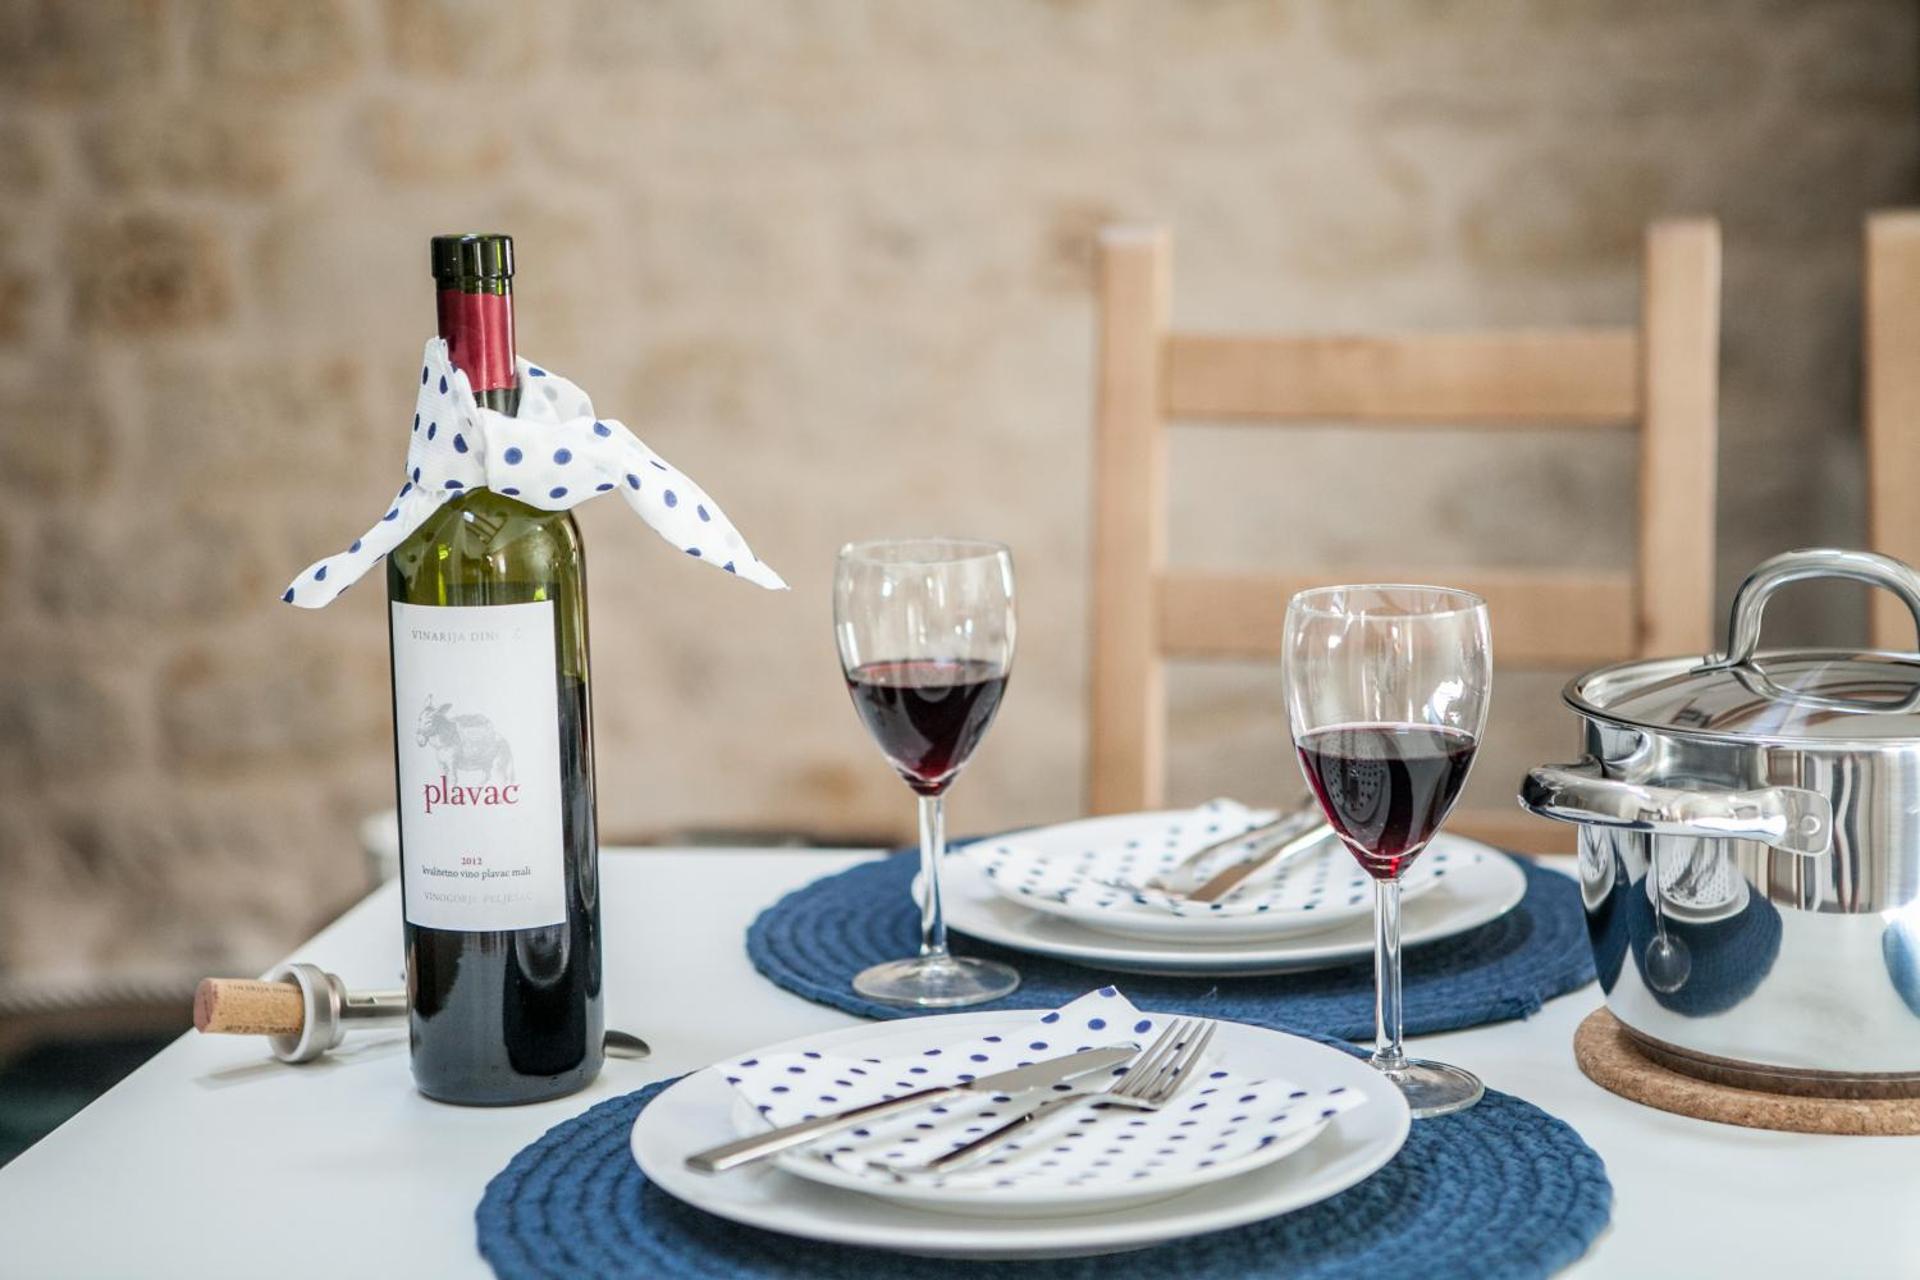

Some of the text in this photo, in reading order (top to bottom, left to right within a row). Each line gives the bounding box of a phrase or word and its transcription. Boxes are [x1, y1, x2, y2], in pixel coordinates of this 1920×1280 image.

[411, 630, 466, 642] VINARIJA
[424, 775, 520, 813] plavac
[461, 857, 482, 865] 2012
[460, 868, 480, 878] vino
[482, 869, 508, 881] plavac
[511, 866, 531, 876] mali
